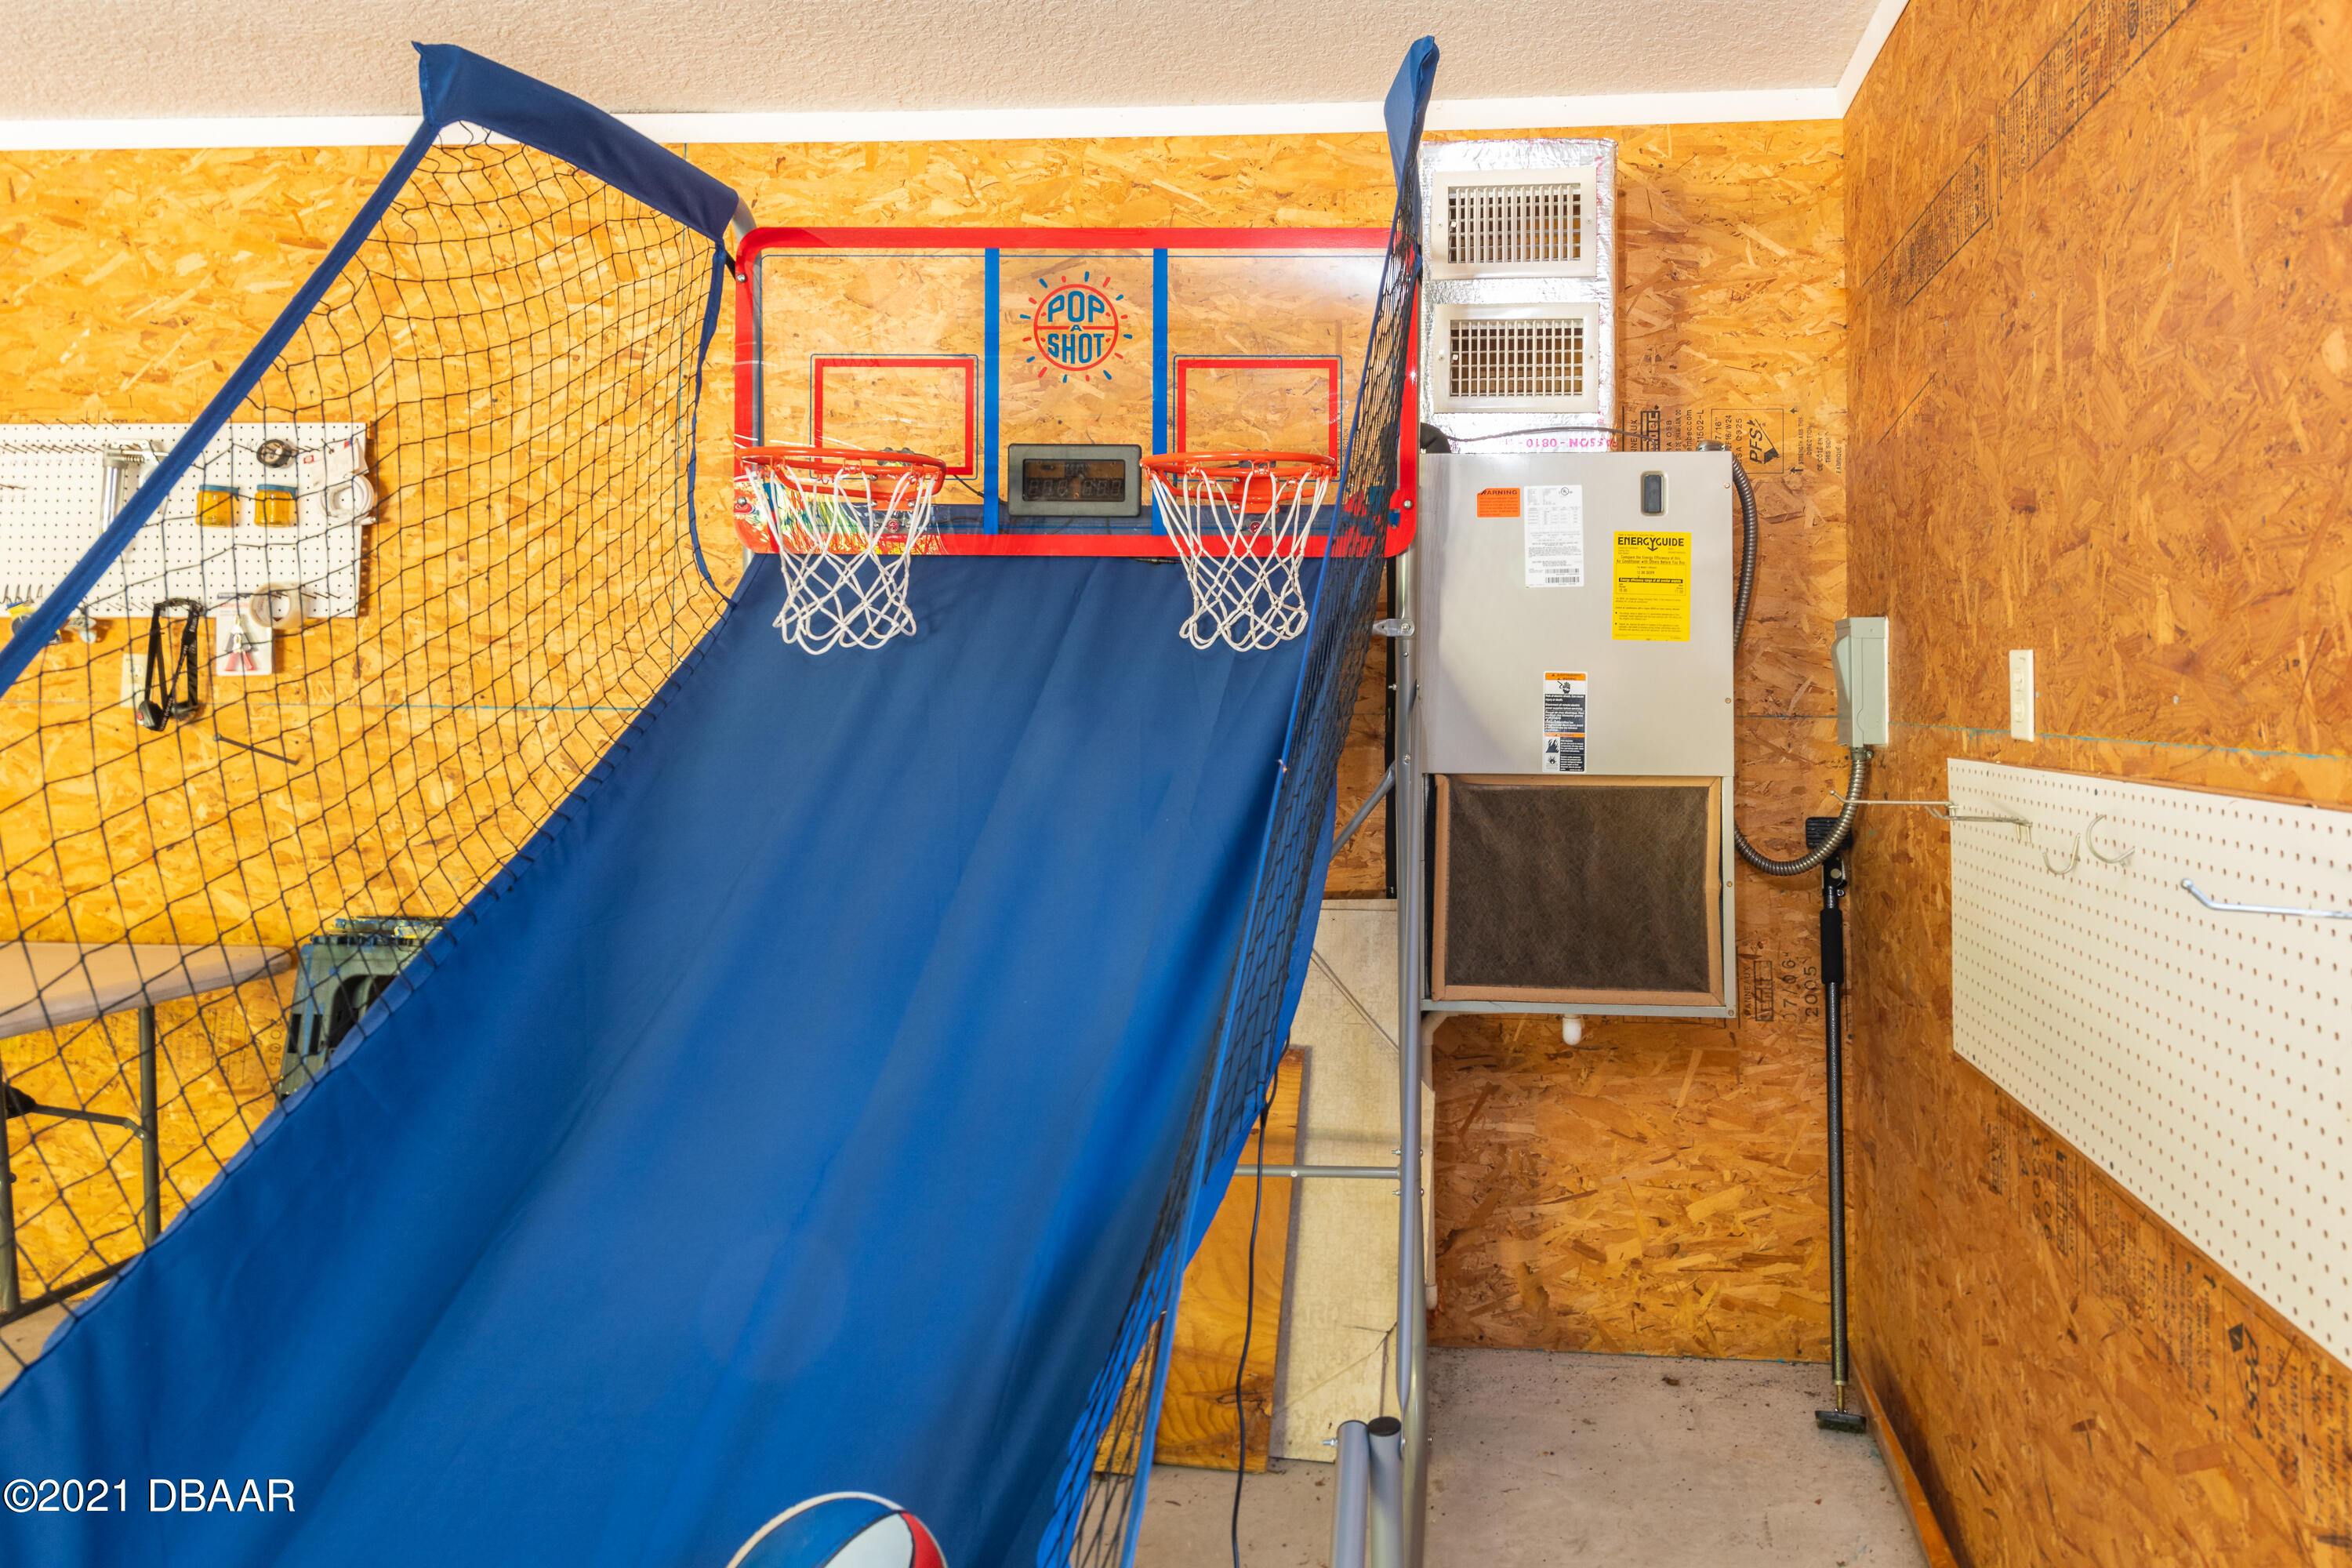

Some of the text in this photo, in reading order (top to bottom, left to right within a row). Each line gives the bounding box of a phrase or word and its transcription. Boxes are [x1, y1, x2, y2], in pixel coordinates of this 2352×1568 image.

[1047, 291, 1105, 323] POP
[1047, 333, 1105, 364] SHOT
[1749, 427, 1762, 464] PFS
[1617, 536, 1685, 550] ENERGYGUIDE
[1804, 966, 1819, 1018] 2005
